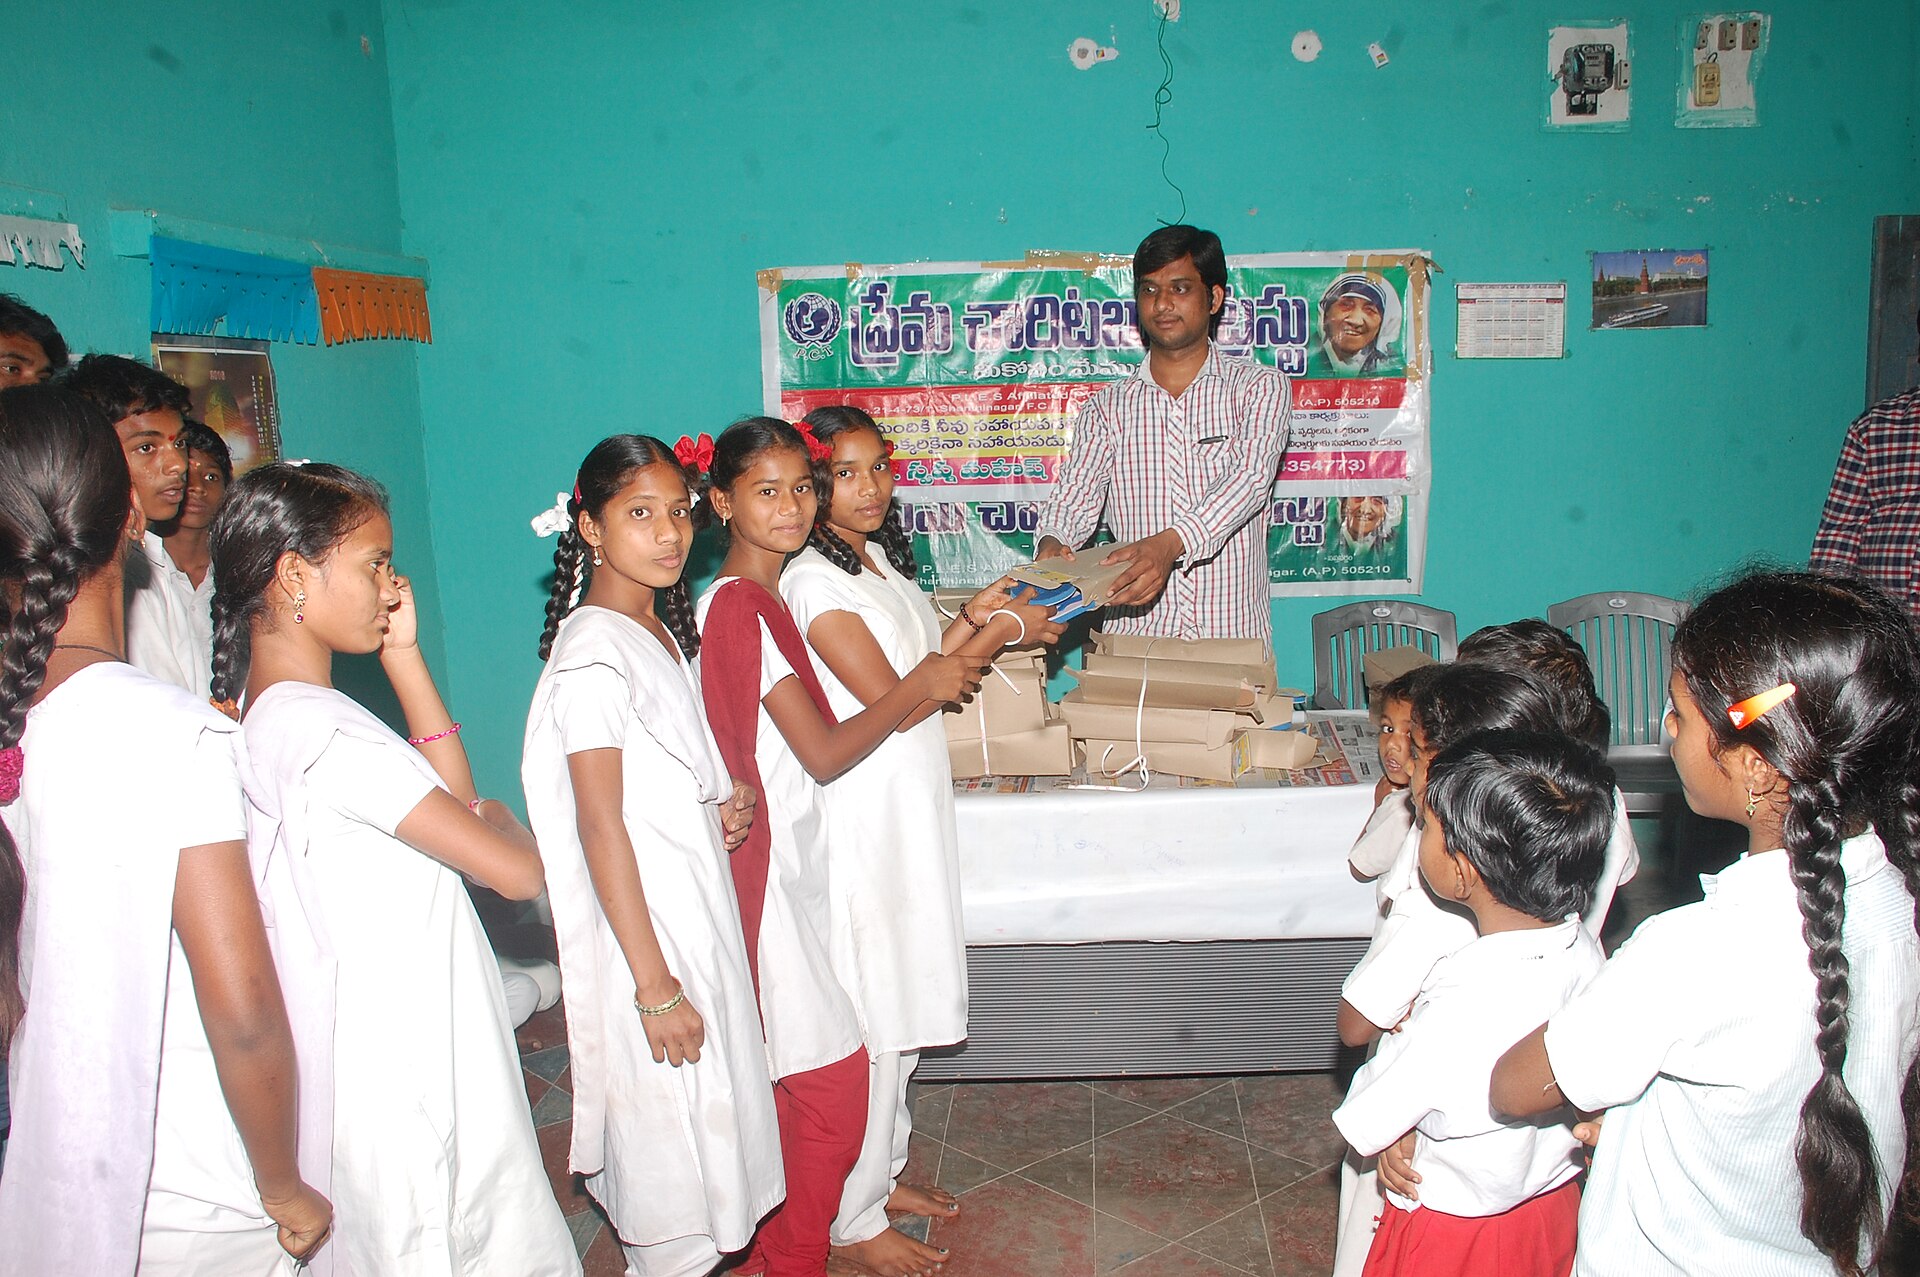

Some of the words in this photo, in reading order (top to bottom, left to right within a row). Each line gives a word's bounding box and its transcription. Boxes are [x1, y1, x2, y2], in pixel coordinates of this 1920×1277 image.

[850, 281, 953, 367] ప్రేమ
[963, 289, 1137, 352] చారిటబు
[793, 345, 833, 360] P.C.T
[1069, 357, 1141, 377] మేము
[1300, 398, 1331, 408] (A.P)
[937, 418, 968, 435] నీవు
[893, 435, 963, 454] క్కరికైనా
[961, 457, 1048, 479] మహేష్
[1303, 566, 1336, 576] (A.P)
[1342, 565, 1390, 574] 505210
